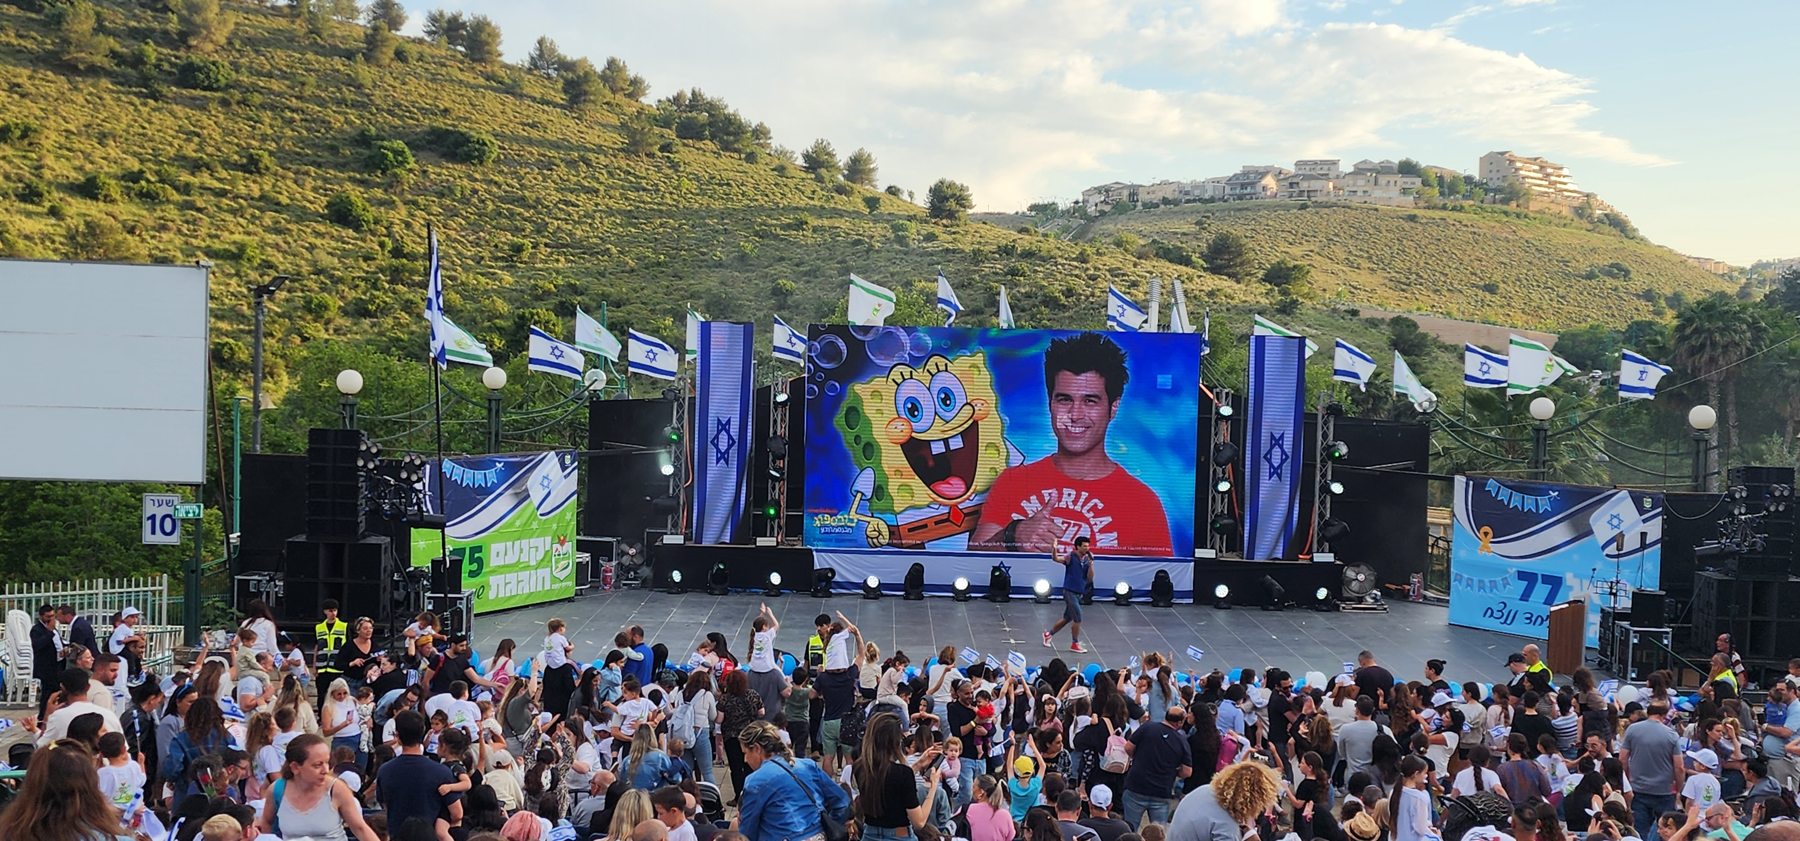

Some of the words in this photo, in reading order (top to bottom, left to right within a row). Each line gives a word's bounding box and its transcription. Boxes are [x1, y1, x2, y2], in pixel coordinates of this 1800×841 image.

[150, 499, 174, 508] שער
[146, 513, 177, 537] 10
[1061, 519, 1083, 543] 77
[489, 536, 552, 567] יקנעם
[488, 567, 551, 600] חוגגת
[1517, 570, 1563, 606] 77
[1482, 601, 1519, 626] ננצח
